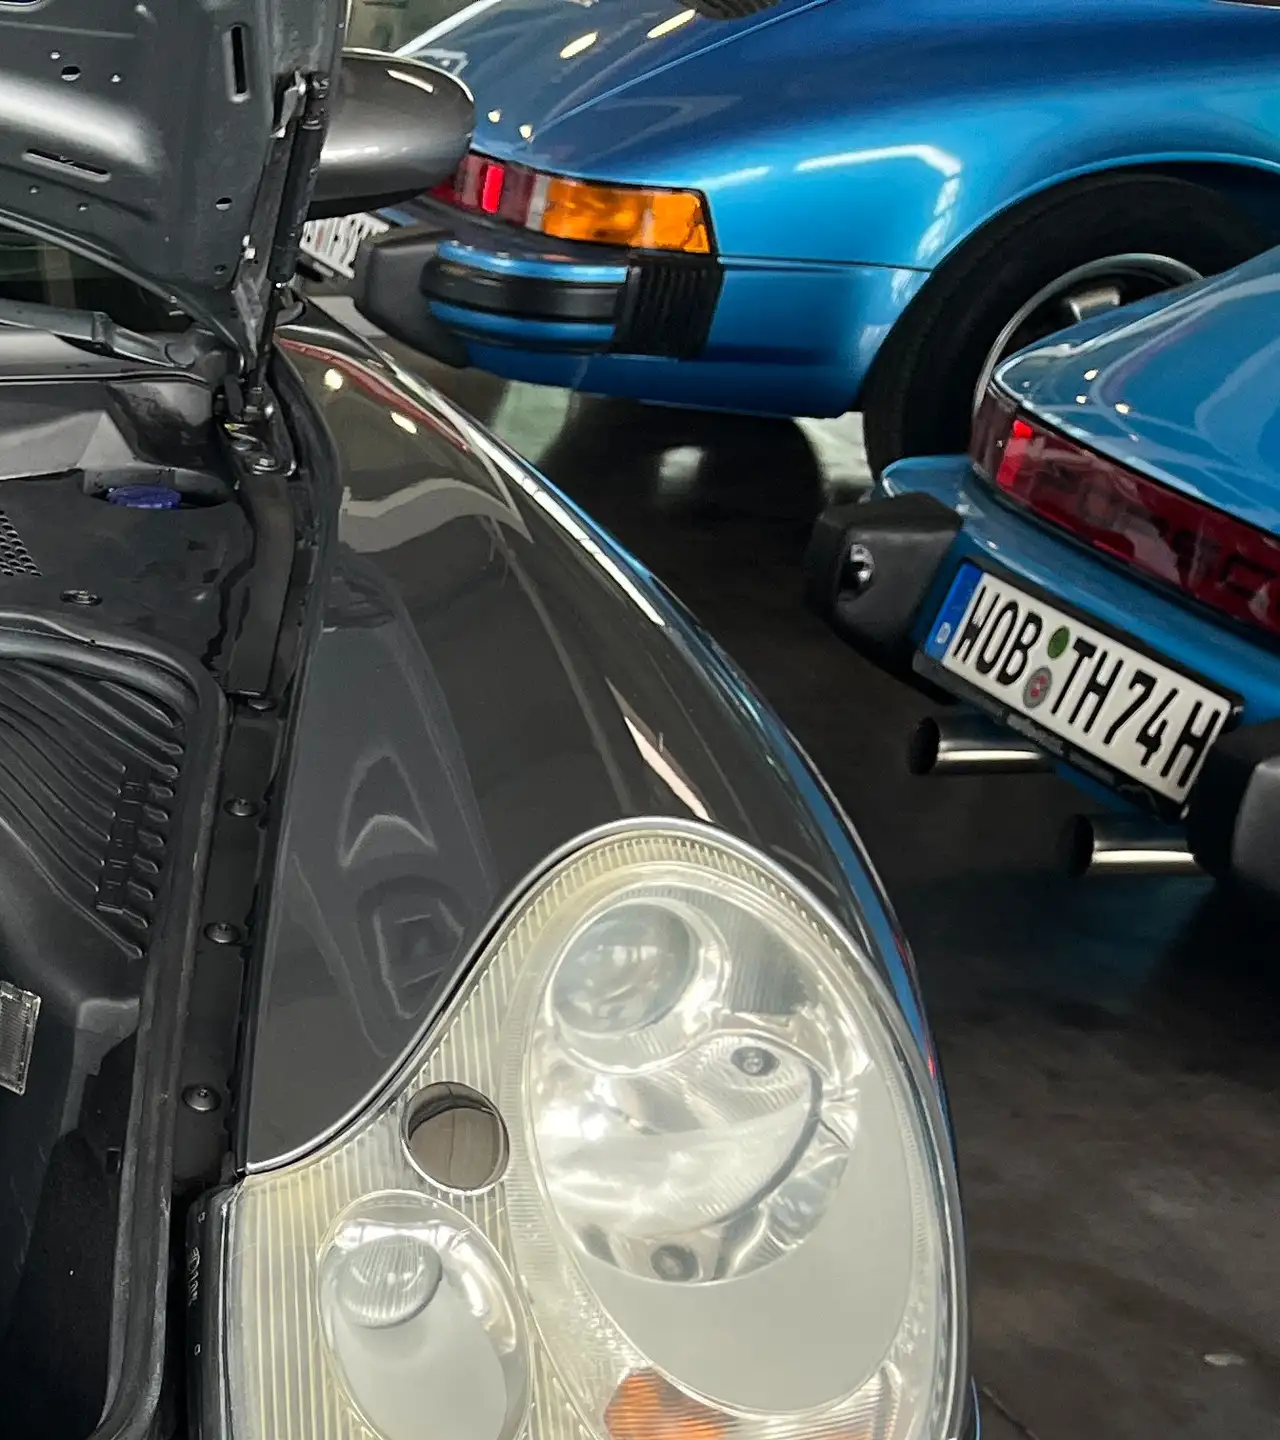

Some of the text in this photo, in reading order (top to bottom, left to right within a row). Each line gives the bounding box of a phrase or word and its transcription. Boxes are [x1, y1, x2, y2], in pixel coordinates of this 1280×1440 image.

[953, 586, 1042, 686] WOB
[1051, 637, 1124, 734] TH
[1103, 670, 1221, 789] 74H
